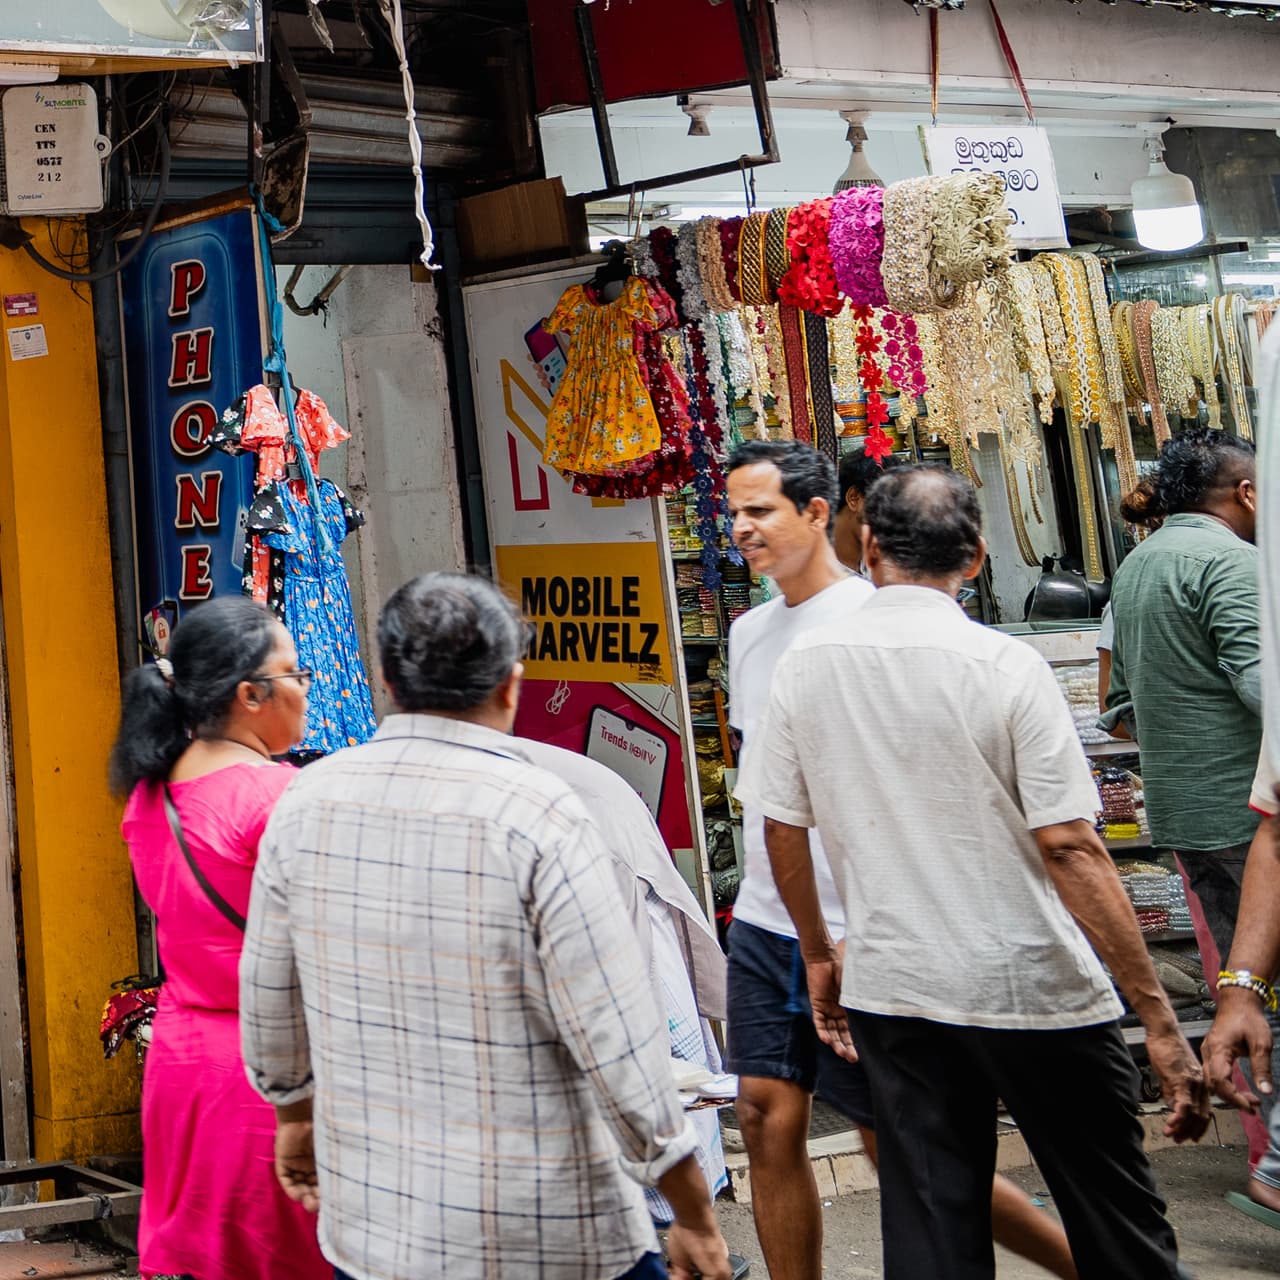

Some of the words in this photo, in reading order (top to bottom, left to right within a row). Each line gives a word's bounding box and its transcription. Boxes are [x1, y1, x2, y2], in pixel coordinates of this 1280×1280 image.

[168, 259, 224, 600] PHONE
[522, 576, 640, 618] MOBILE
[600, 724, 628, 752] Trends
